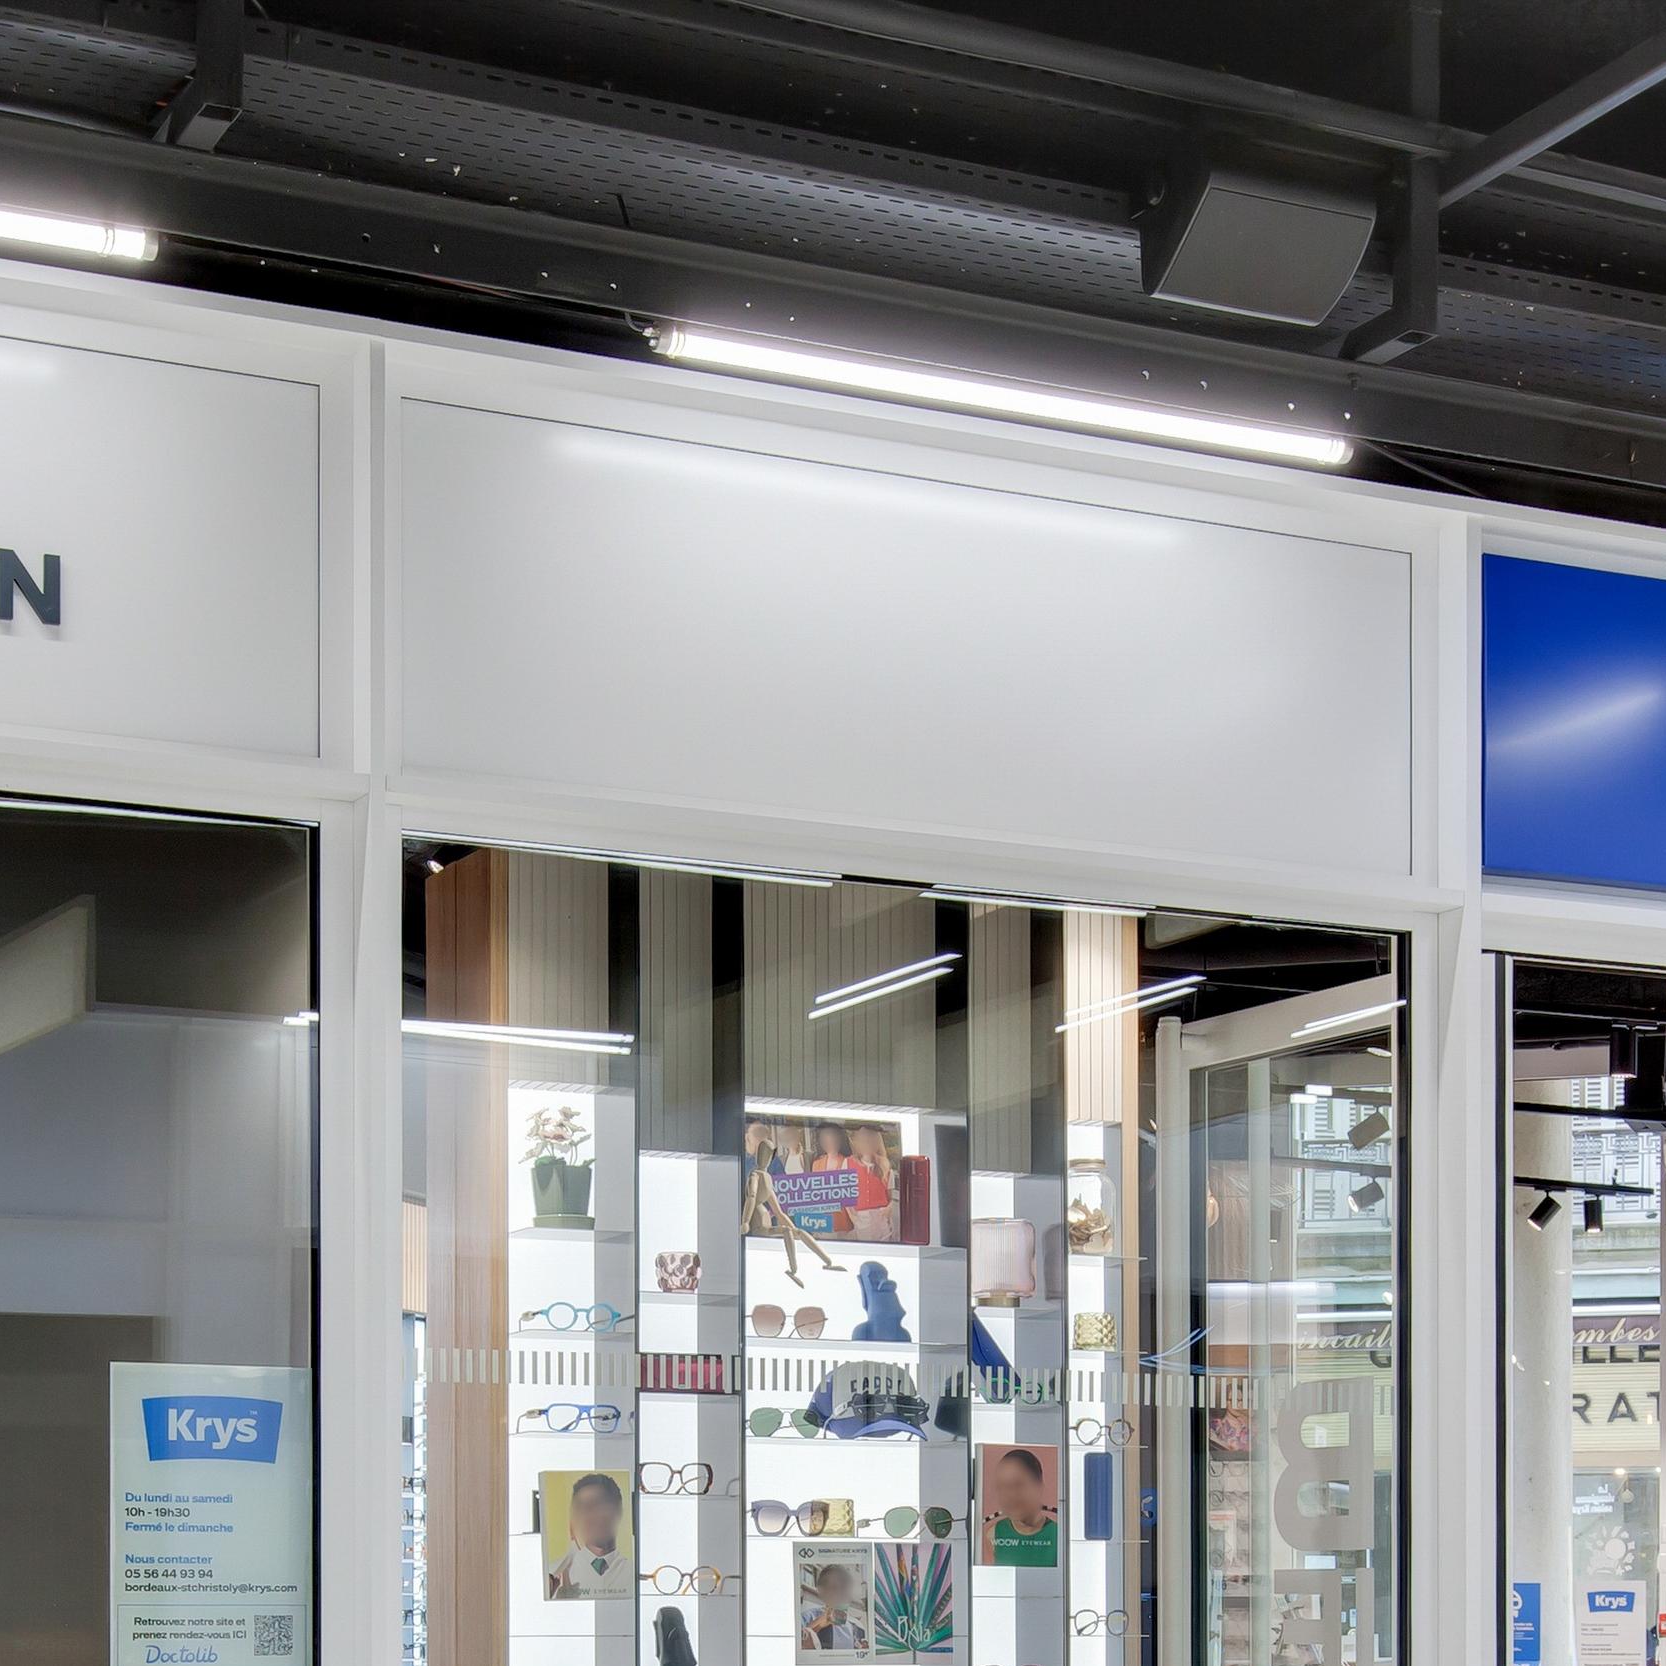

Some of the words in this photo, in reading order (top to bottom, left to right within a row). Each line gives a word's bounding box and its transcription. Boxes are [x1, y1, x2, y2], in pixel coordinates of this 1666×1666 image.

[777, 1187, 860, 1205] OLLECTIONS
[800, 1216, 827, 1229] Krys
[167, 1408, 259, 1450] Krys
[125, 1492, 141, 1504] Du
[144, 1492, 173, 1504] lundi
[175, 1494, 190, 1504] au
[192, 1493, 233, 1504] samedi
[125, 1507, 145, 1518] 10h
[154, 1507, 190, 1518] 19h30
[125, 1521, 162, 1533] Fermé
[165, 1521, 175, 1533] le
[177, 1521, 234, 1533] dimanche
[125, 1554, 155, 1565] Nous
[158, 1554, 213, 1565] contacter
[125, 1569, 141, 1579] 05
[161, 1569, 177, 1579] 44
[1595, 1595, 1628, 1609] Krys
[134, 1616, 185, 1627] Retrouvez
[188, 1617, 214, 1627] notre
[216, 1616, 234, 1627] site
[132, 1631, 166, 1642] prenez
[169, 1630, 231, 1641] rendez-vous
[145, 1645, 218, 1664] Doctolib
